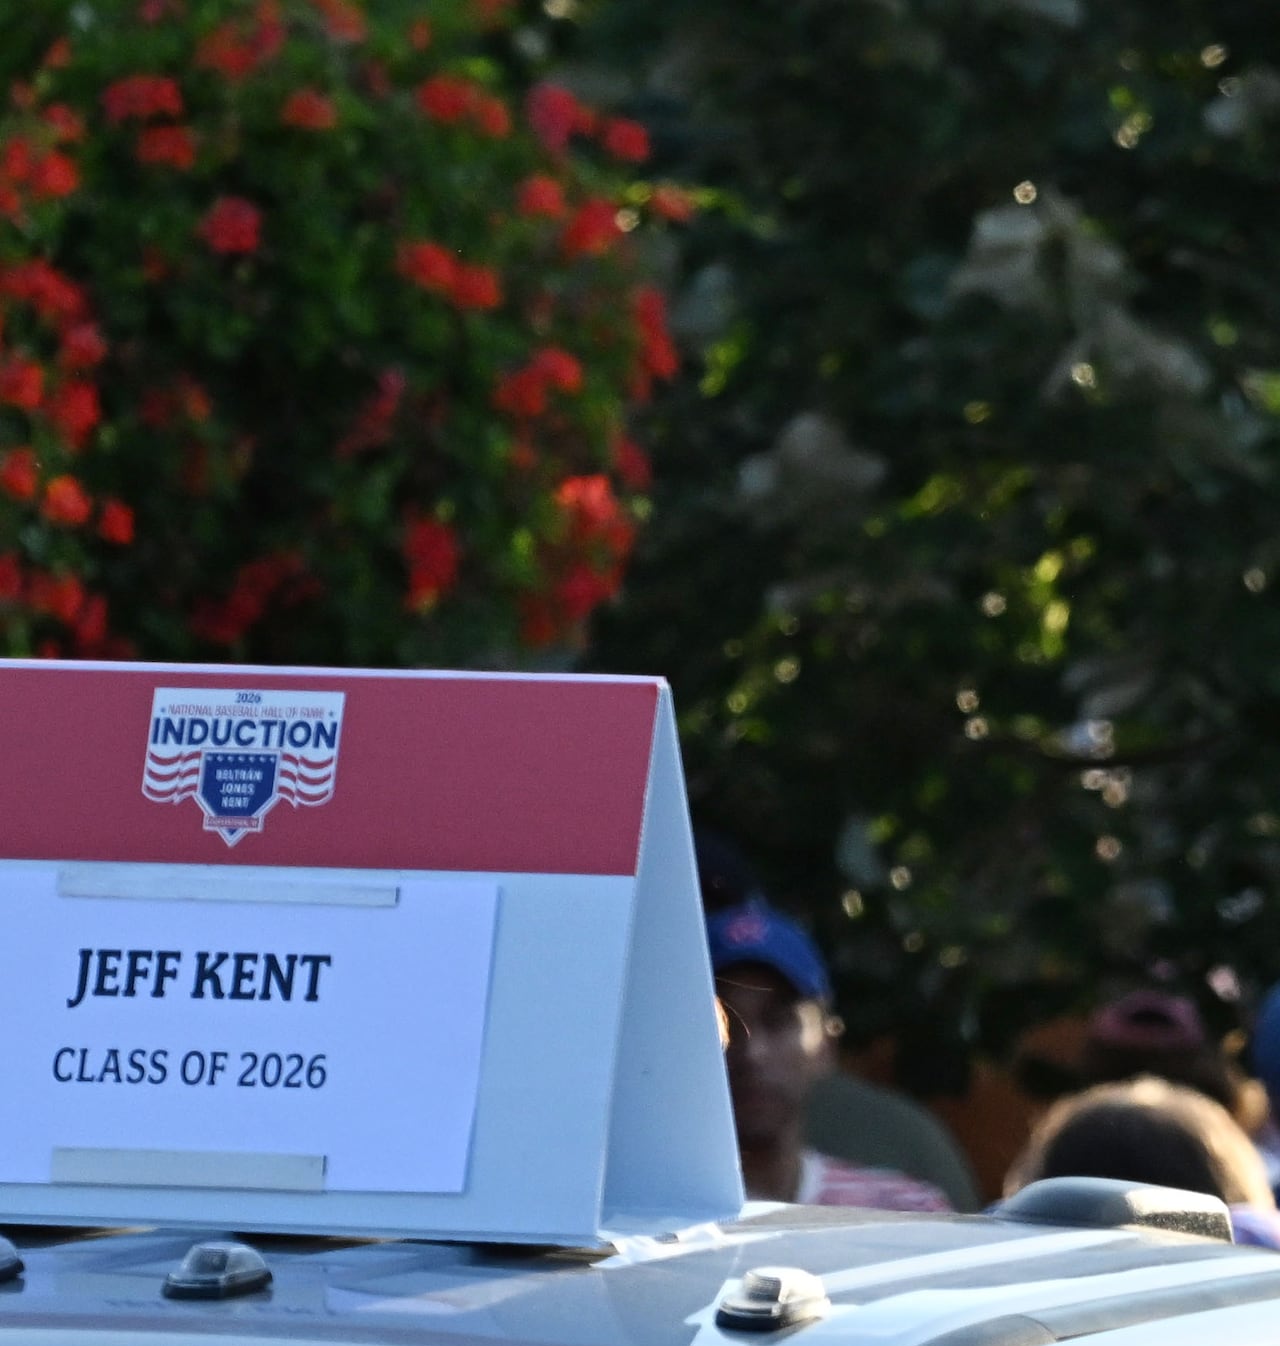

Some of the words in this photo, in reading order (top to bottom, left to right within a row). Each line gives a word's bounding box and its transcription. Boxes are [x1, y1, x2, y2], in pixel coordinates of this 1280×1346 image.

[234, 692, 262, 704] 2026
[167, 704, 212, 717] NATIONAL
[215, 705, 259, 718] BASEBALL
[261, 706, 282, 718] HALL
[285, 706, 298, 718] OF
[300, 706, 325, 719] FAME
[151, 717, 338, 749] INDUCTION
[219, 783, 256, 795] JONES
[221, 796, 250, 808] KENT
[66, 947, 182, 1009] JEFF
[190, 951, 332, 1002] KENT
[52, 1046, 169, 1085] CLASS
[180, 1049, 229, 1086] OF
[236, 1051, 328, 1089] 2026
